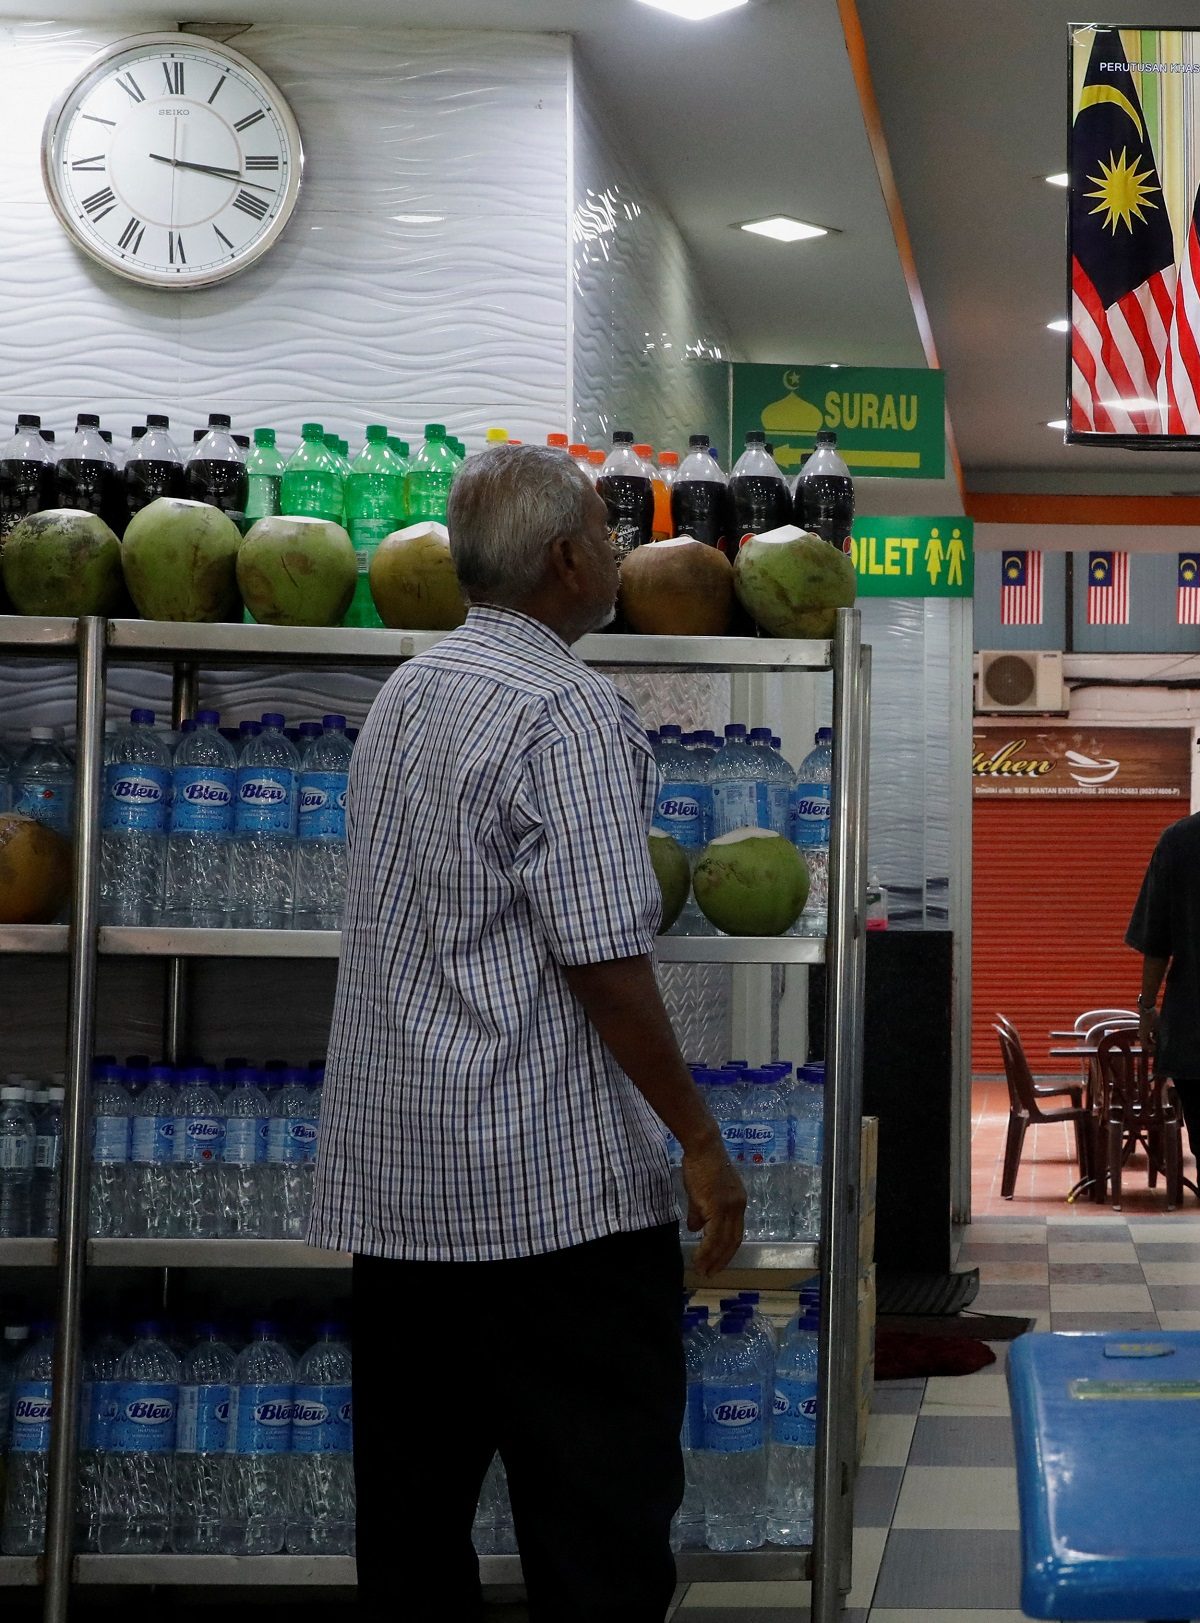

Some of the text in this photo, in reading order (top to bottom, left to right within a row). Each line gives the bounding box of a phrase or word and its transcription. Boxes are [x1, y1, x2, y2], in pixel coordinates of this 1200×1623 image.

[1100, 62, 1200, 73] PERUTUSAN KHAS
[824, 391, 918, 431] SURAU
[851, 537, 919, 576] ILET
[114, 781, 160, 799] Bleu
[186, 784, 229, 802] Bleu
[242, 783, 284, 800] Bleu
[300, 792, 324, 807] leu
[661, 800, 698, 816] Bleu
[188, 1124, 219, 1137] Bleu
[128, 1402, 172, 1419] Bleu
[257, 1404, 291, 1421] Ble
[715, 1405, 757, 1421] Bleu
